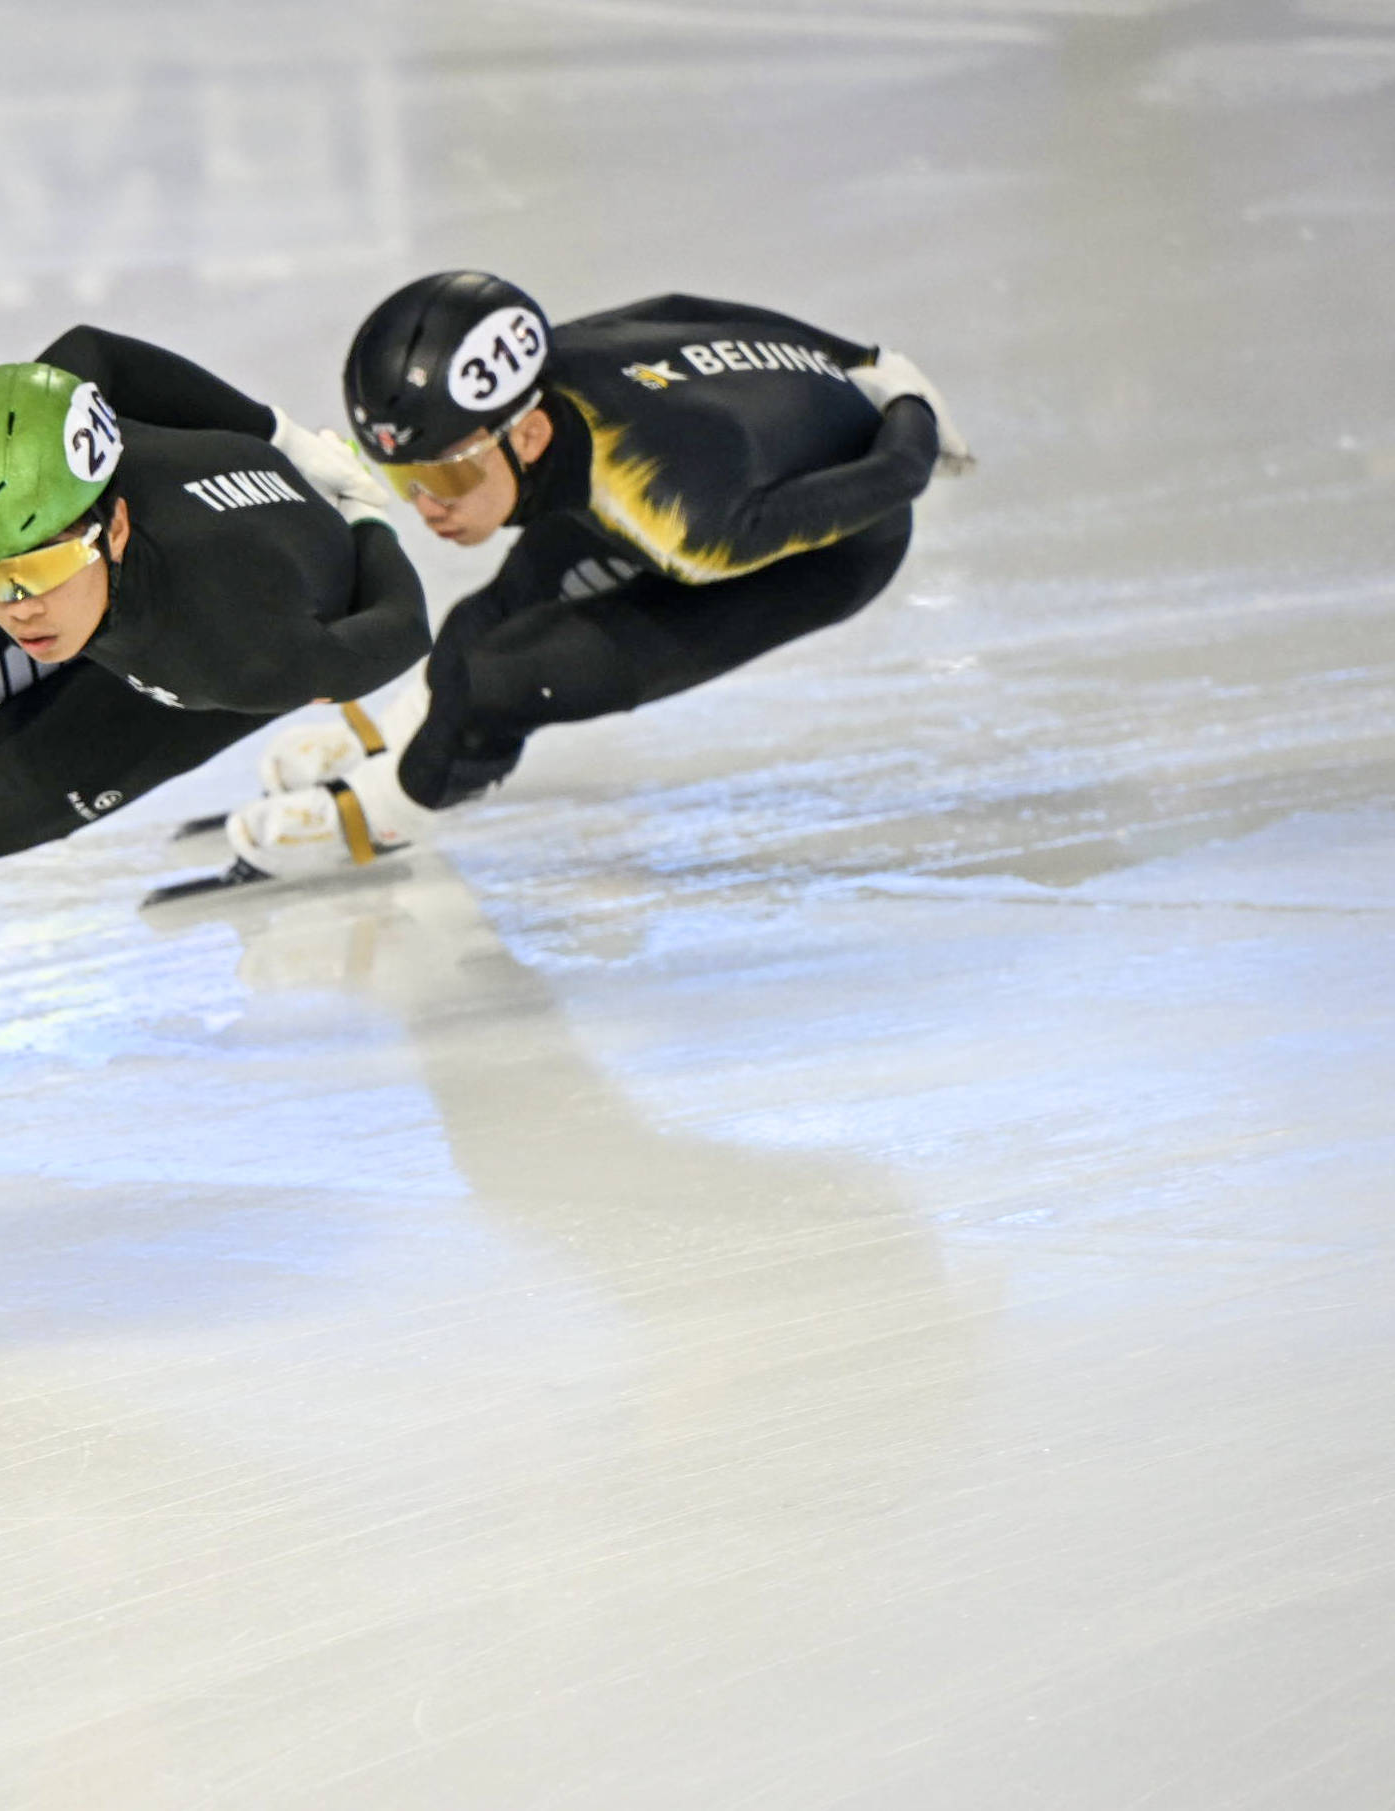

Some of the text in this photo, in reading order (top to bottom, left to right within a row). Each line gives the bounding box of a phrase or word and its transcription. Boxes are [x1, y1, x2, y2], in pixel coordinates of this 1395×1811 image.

[460, 315, 540, 400] 315
[679, 340, 848, 383] BEIJING
[183, 470, 307, 512] TIANJIN
